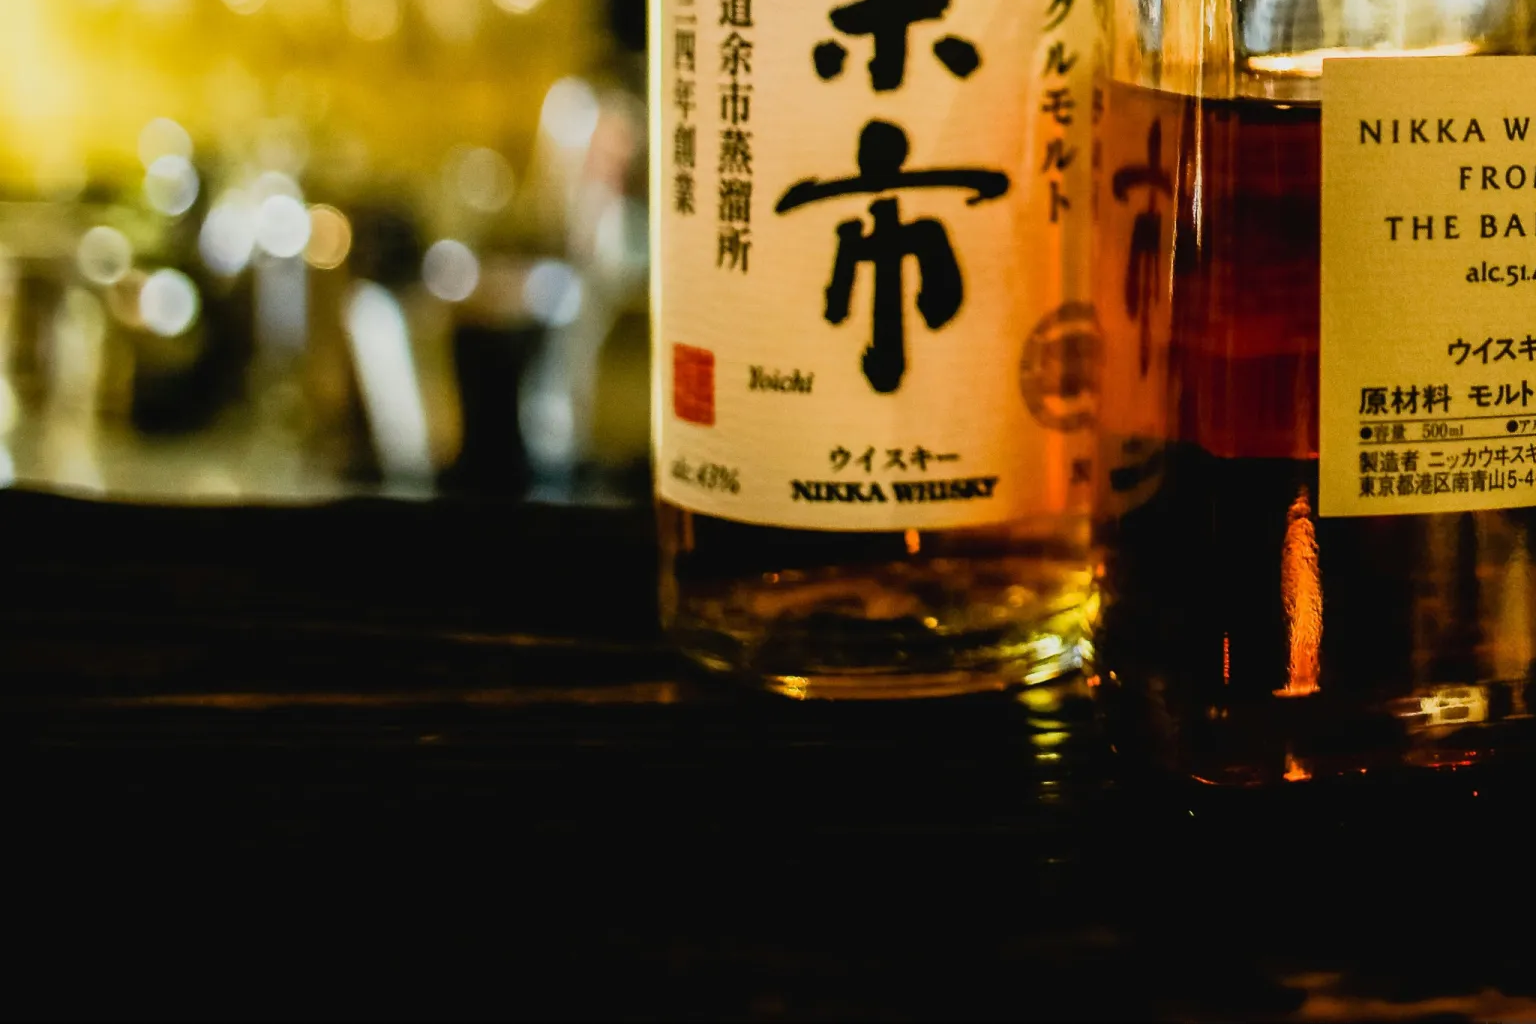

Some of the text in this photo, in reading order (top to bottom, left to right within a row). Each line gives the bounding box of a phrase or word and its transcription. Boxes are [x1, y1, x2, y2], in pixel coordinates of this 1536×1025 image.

[1360, 118, 1486, 145] NIKKA
[1384, 215, 1461, 241] THE
[1359, 384, 1452, 415] 原材料
[829, 446, 960, 472] ウイスキー
[1359, 450, 1419, 473] 製造者
[790, 476, 999, 503] NIKKA WHISKY
